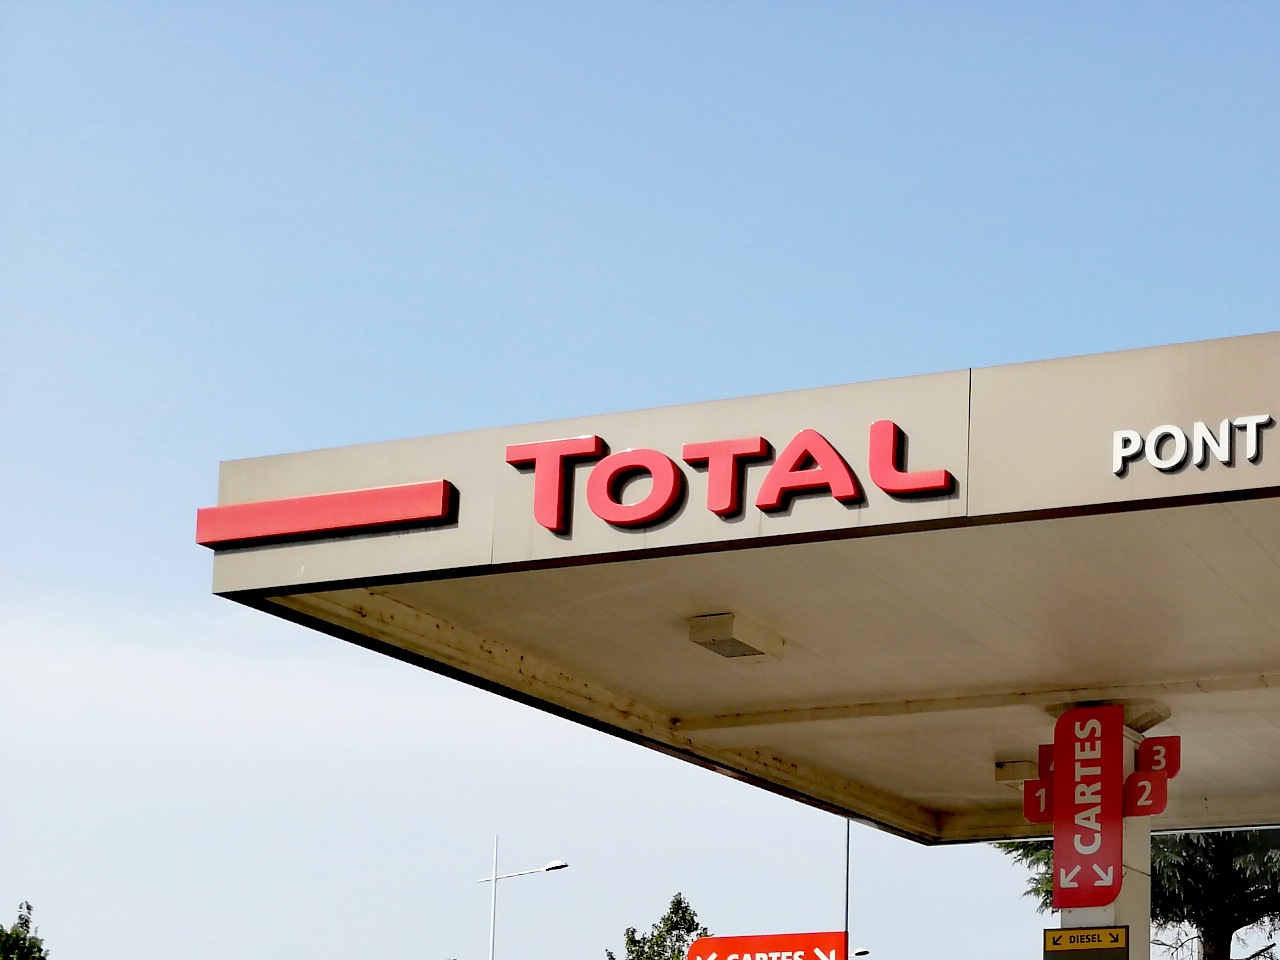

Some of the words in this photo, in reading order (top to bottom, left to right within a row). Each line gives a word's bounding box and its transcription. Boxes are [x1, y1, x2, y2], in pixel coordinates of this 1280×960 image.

[1112, 413, 1271, 475] PONT
[505, 419, 954, 535] TOTAL
[1151, 745, 1167, 771] 3
[1074, 718, 1102, 855] CARTES
[1137, 781, 1153, 807] 2
[1034, 788, 1046, 813] 1
[1069, 933, 1103, 944] DIESEL
